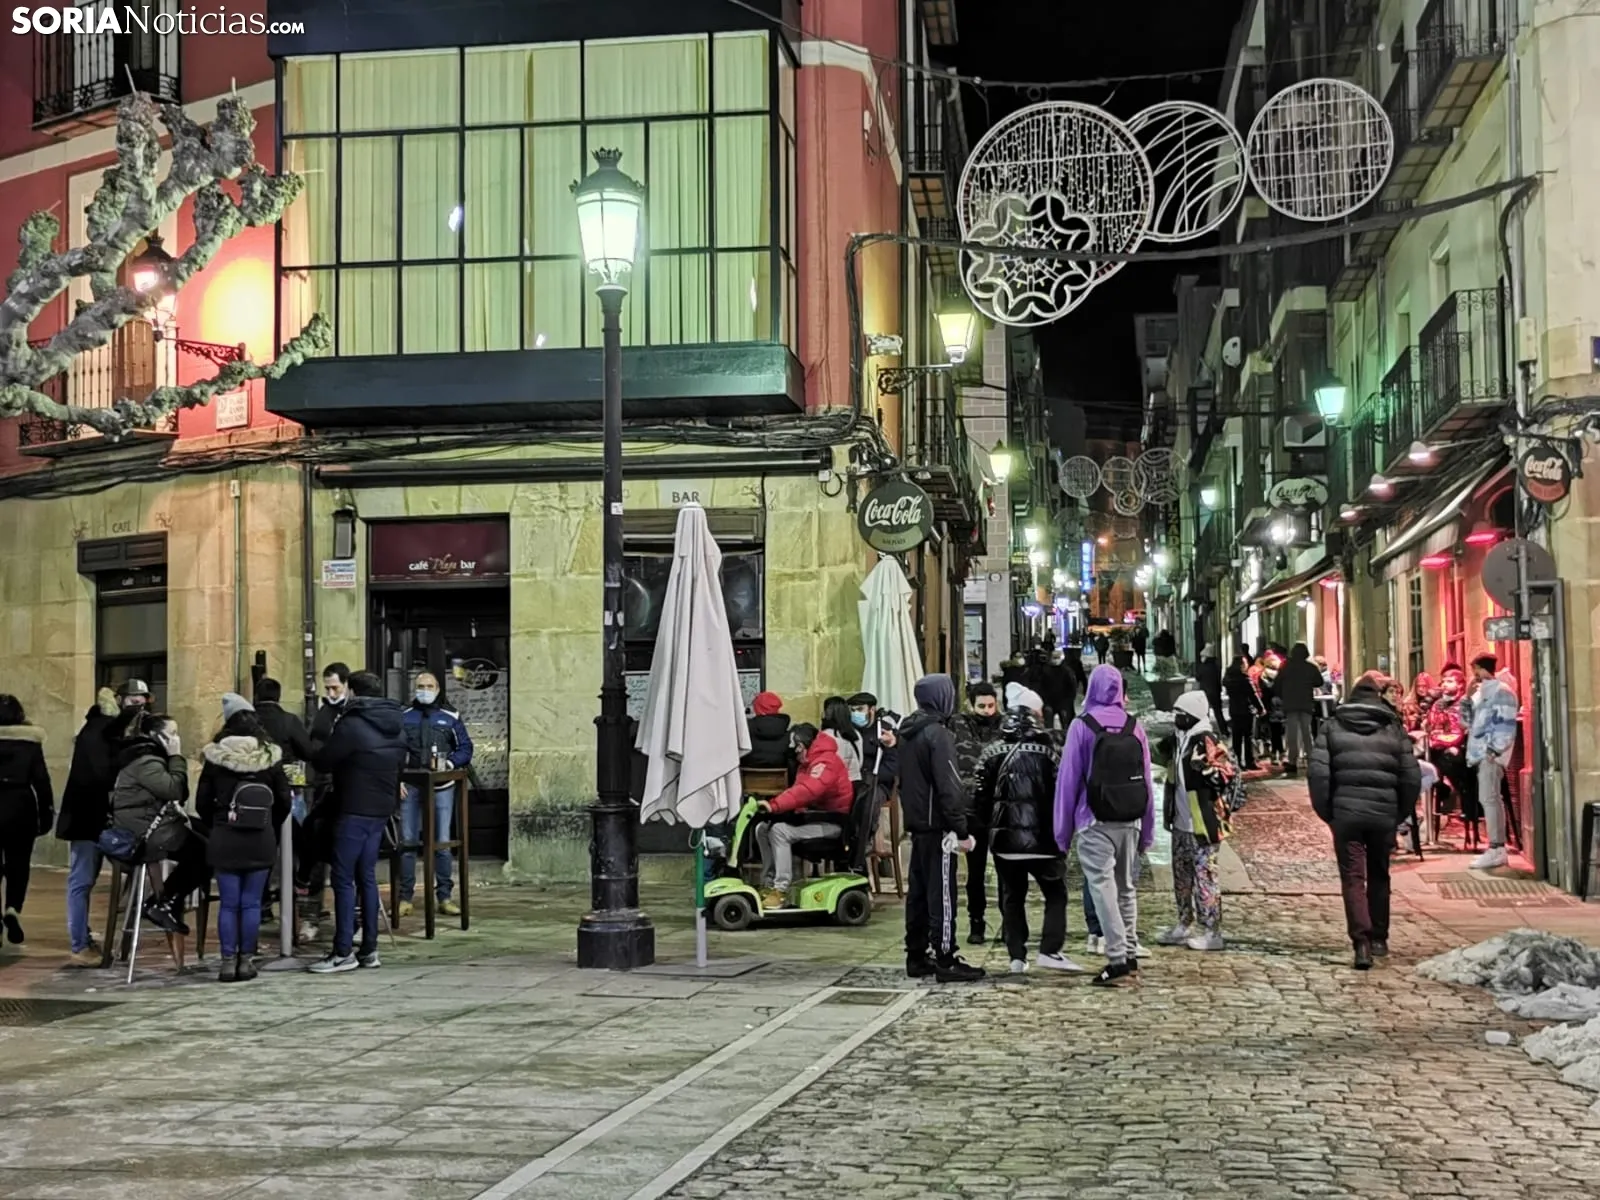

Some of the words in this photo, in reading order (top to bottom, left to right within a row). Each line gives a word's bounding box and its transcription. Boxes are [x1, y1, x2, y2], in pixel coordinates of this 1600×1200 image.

[672, 491, 701, 503] BAR
[864, 495, 924, 527] Coca-Cola
[408, 560, 429, 571] café
[460, 559, 476, 569] bar
